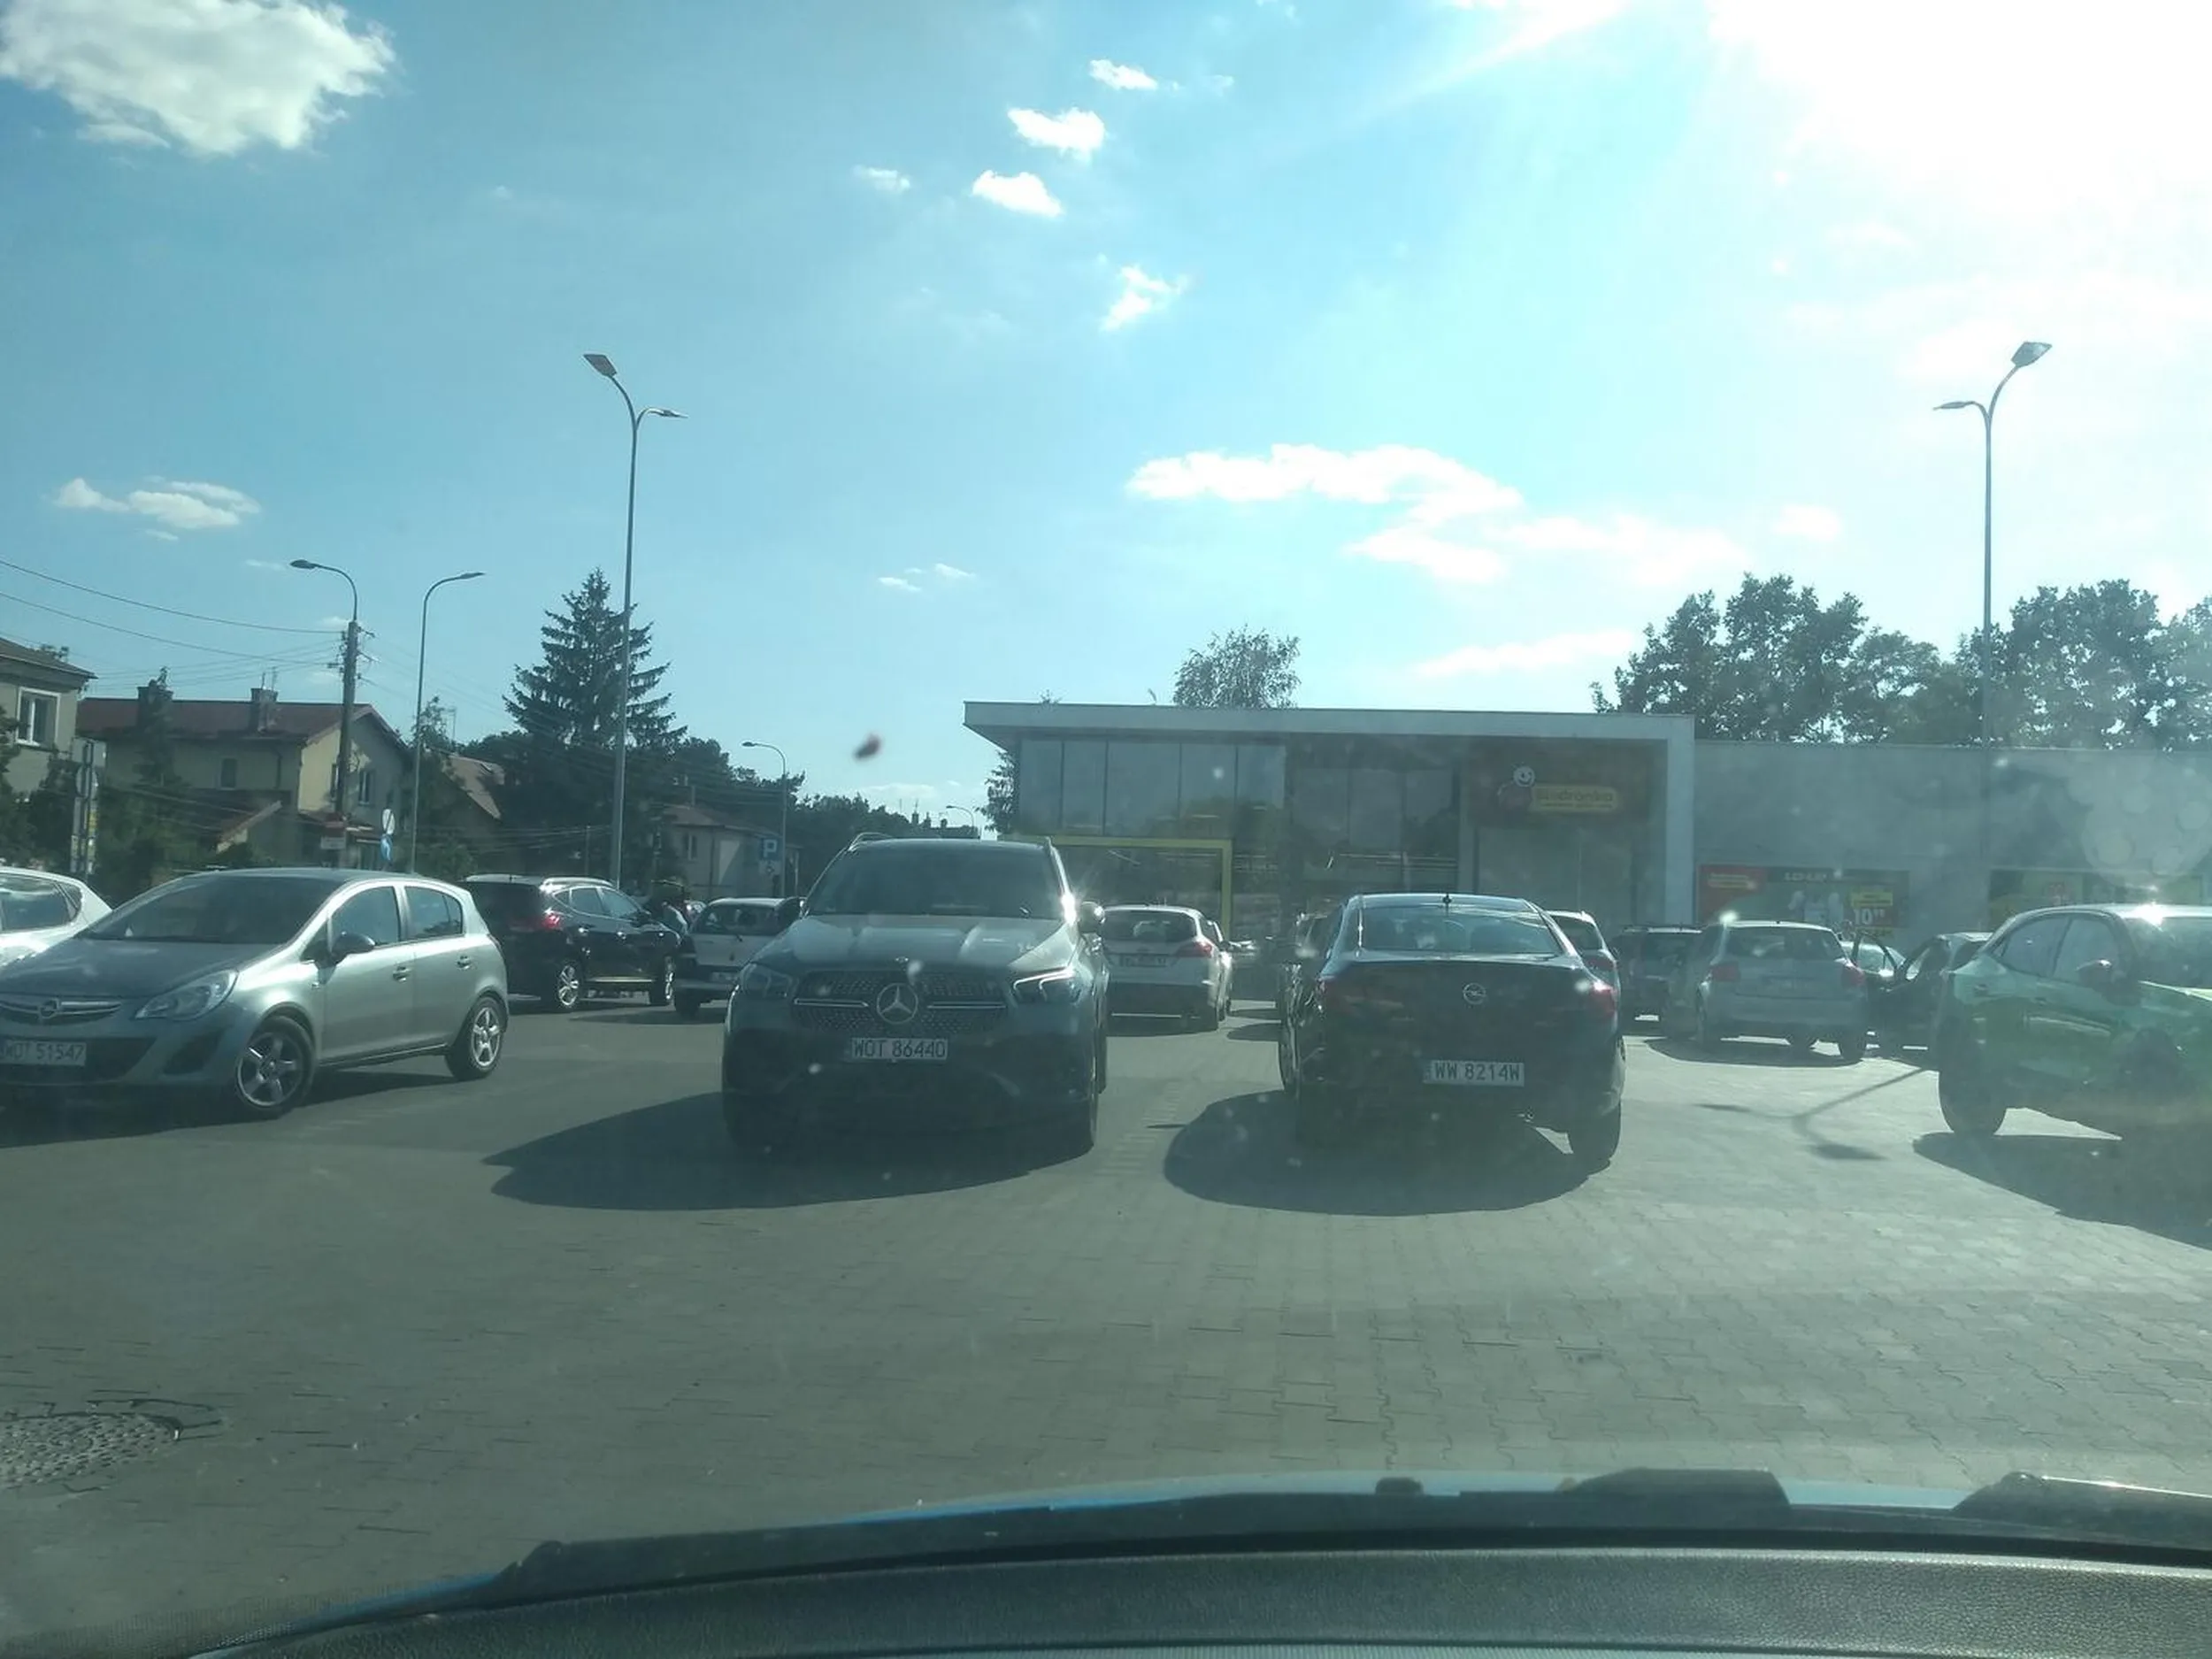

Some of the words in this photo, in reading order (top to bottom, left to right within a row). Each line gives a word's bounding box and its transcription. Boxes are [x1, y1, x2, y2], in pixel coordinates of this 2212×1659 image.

[763, 839, 778, 858] P
[36, 1042, 85, 1062] 51547
[853, 1039, 887, 1058] WOT
[891, 1038, 946, 1058] 86440
[1434, 1062, 1458, 1080] WW
[1463, 1063, 1521, 1082] 8214W
